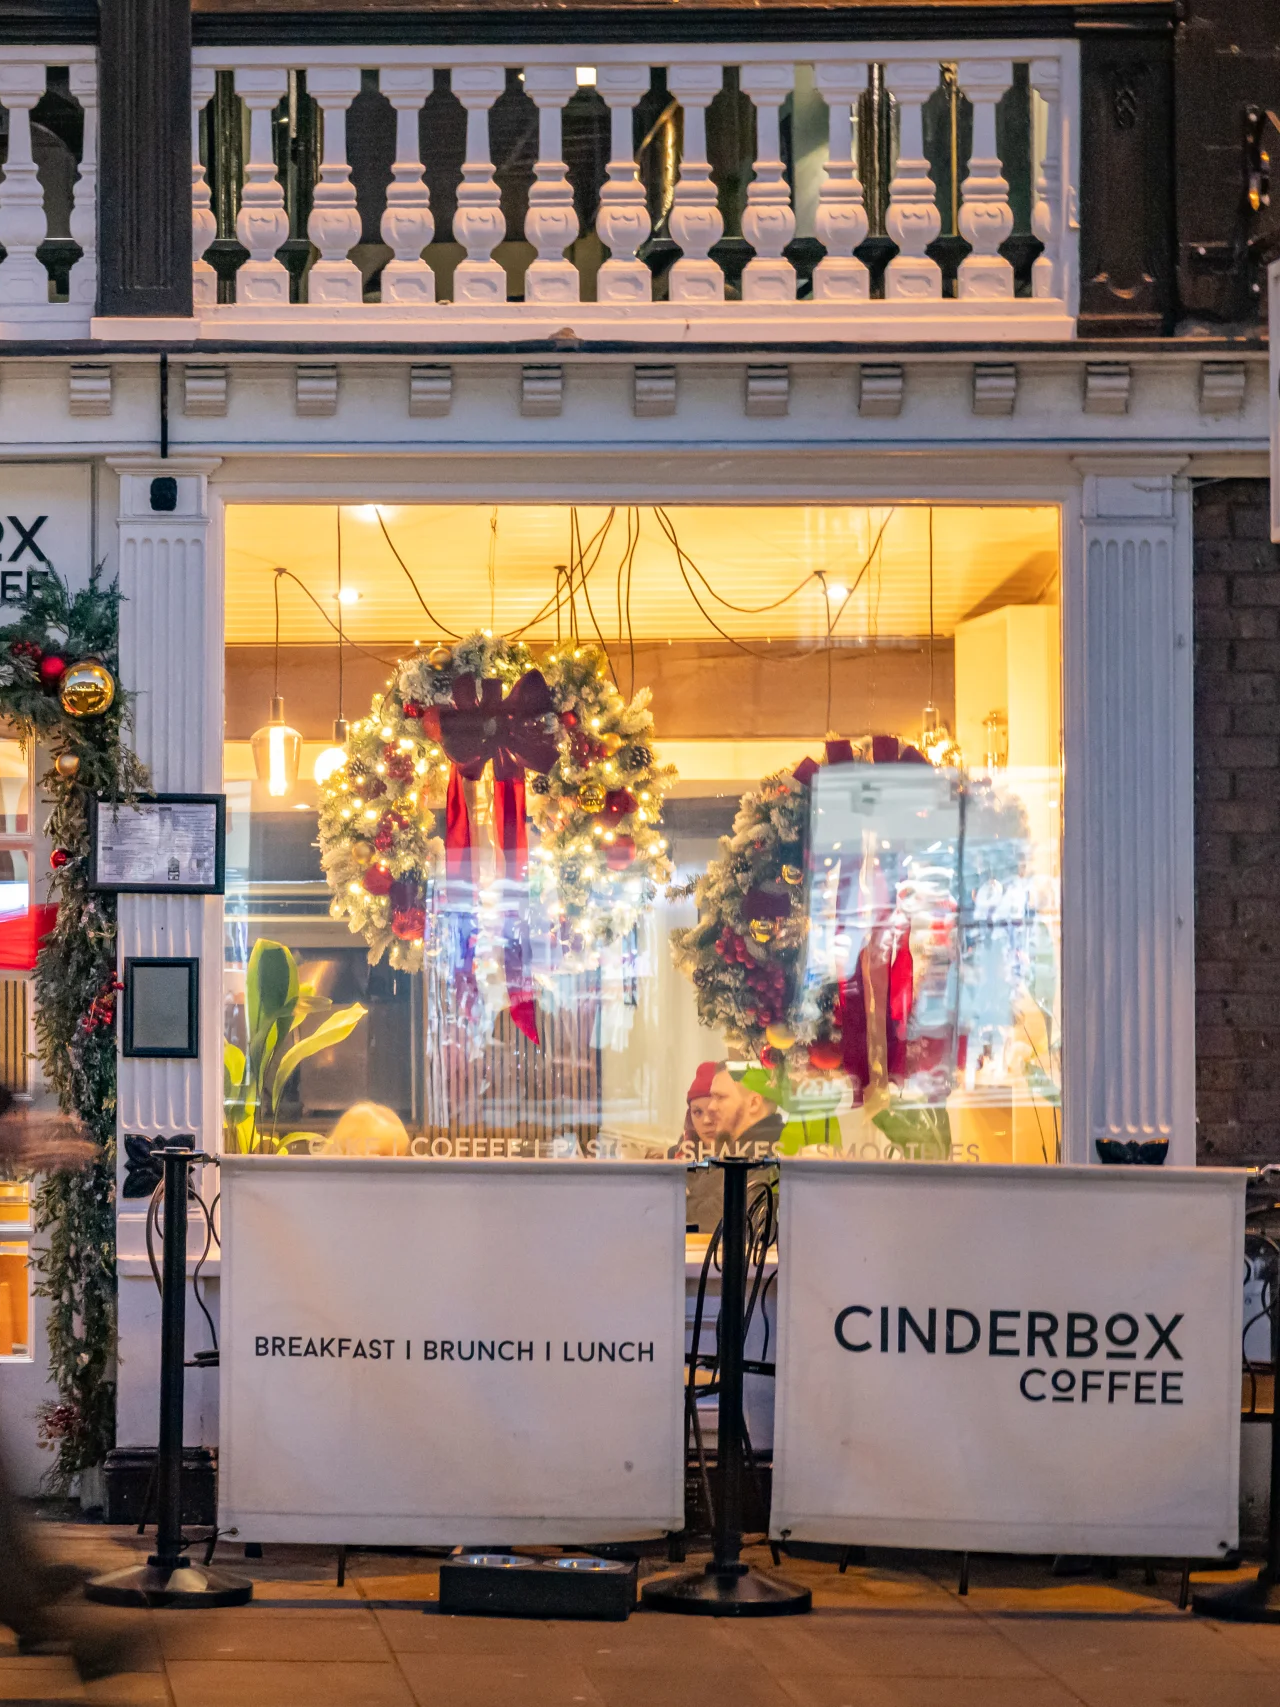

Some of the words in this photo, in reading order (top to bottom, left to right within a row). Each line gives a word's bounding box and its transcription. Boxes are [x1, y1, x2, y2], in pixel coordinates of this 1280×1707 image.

[410, 1136, 523, 1158] COFFEE
[681, 1141, 785, 1161] SHAKES
[833, 1305, 1185, 1361] CINDERBOX
[254, 1336, 395, 1360] BREAKFAST
[423, 1340, 534, 1362] BRUNCH
[563, 1341, 654, 1363] LUNCH
[1019, 1368, 1184, 1405] COFFEE
